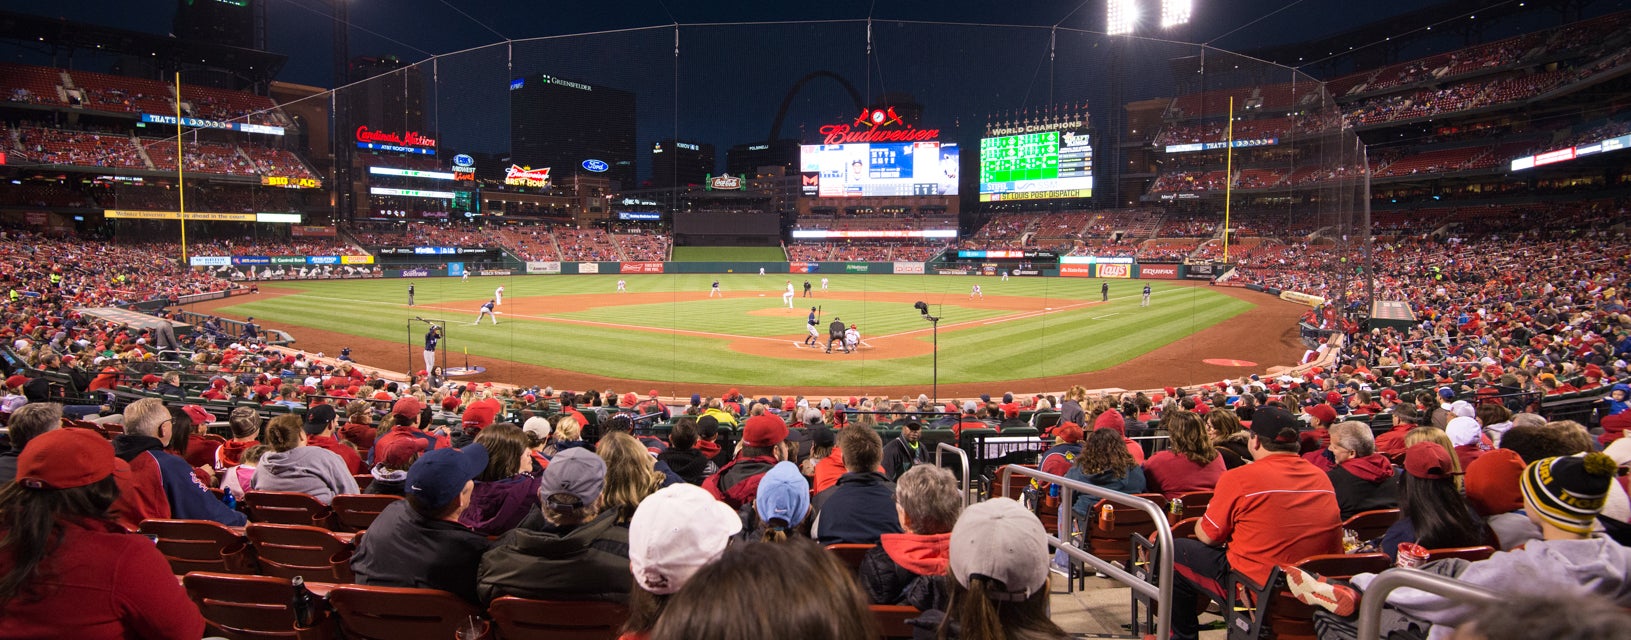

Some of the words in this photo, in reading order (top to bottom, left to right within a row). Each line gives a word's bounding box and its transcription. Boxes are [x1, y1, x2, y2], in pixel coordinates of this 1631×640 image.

[552, 77, 592, 92] GREENSFELDER
[149, 115, 176, 124] THAT'S
[992, 127, 1025, 137] WORLD
[1026, 121, 1083, 133] CHAMPIONS
[356, 125, 401, 143] Cardinals
[400, 131, 436, 148] Nation
[819, 124, 940, 145] Budweiser
[452, 165, 476, 173] MIDWEST
[587, 160, 605, 170] Ford
[505, 167, 550, 180] Budweiser
[268, 176, 289, 186] BIG
[506, 178, 526, 187] BREW
[527, 179, 547, 188] HOUS
[987, 183, 1008, 191] STIFEL
[1012, 191, 1029, 200] LOUIS
[1030, 189, 1080, 199] POST-DISPATCH
[402, 269, 428, 277] Scottrade
